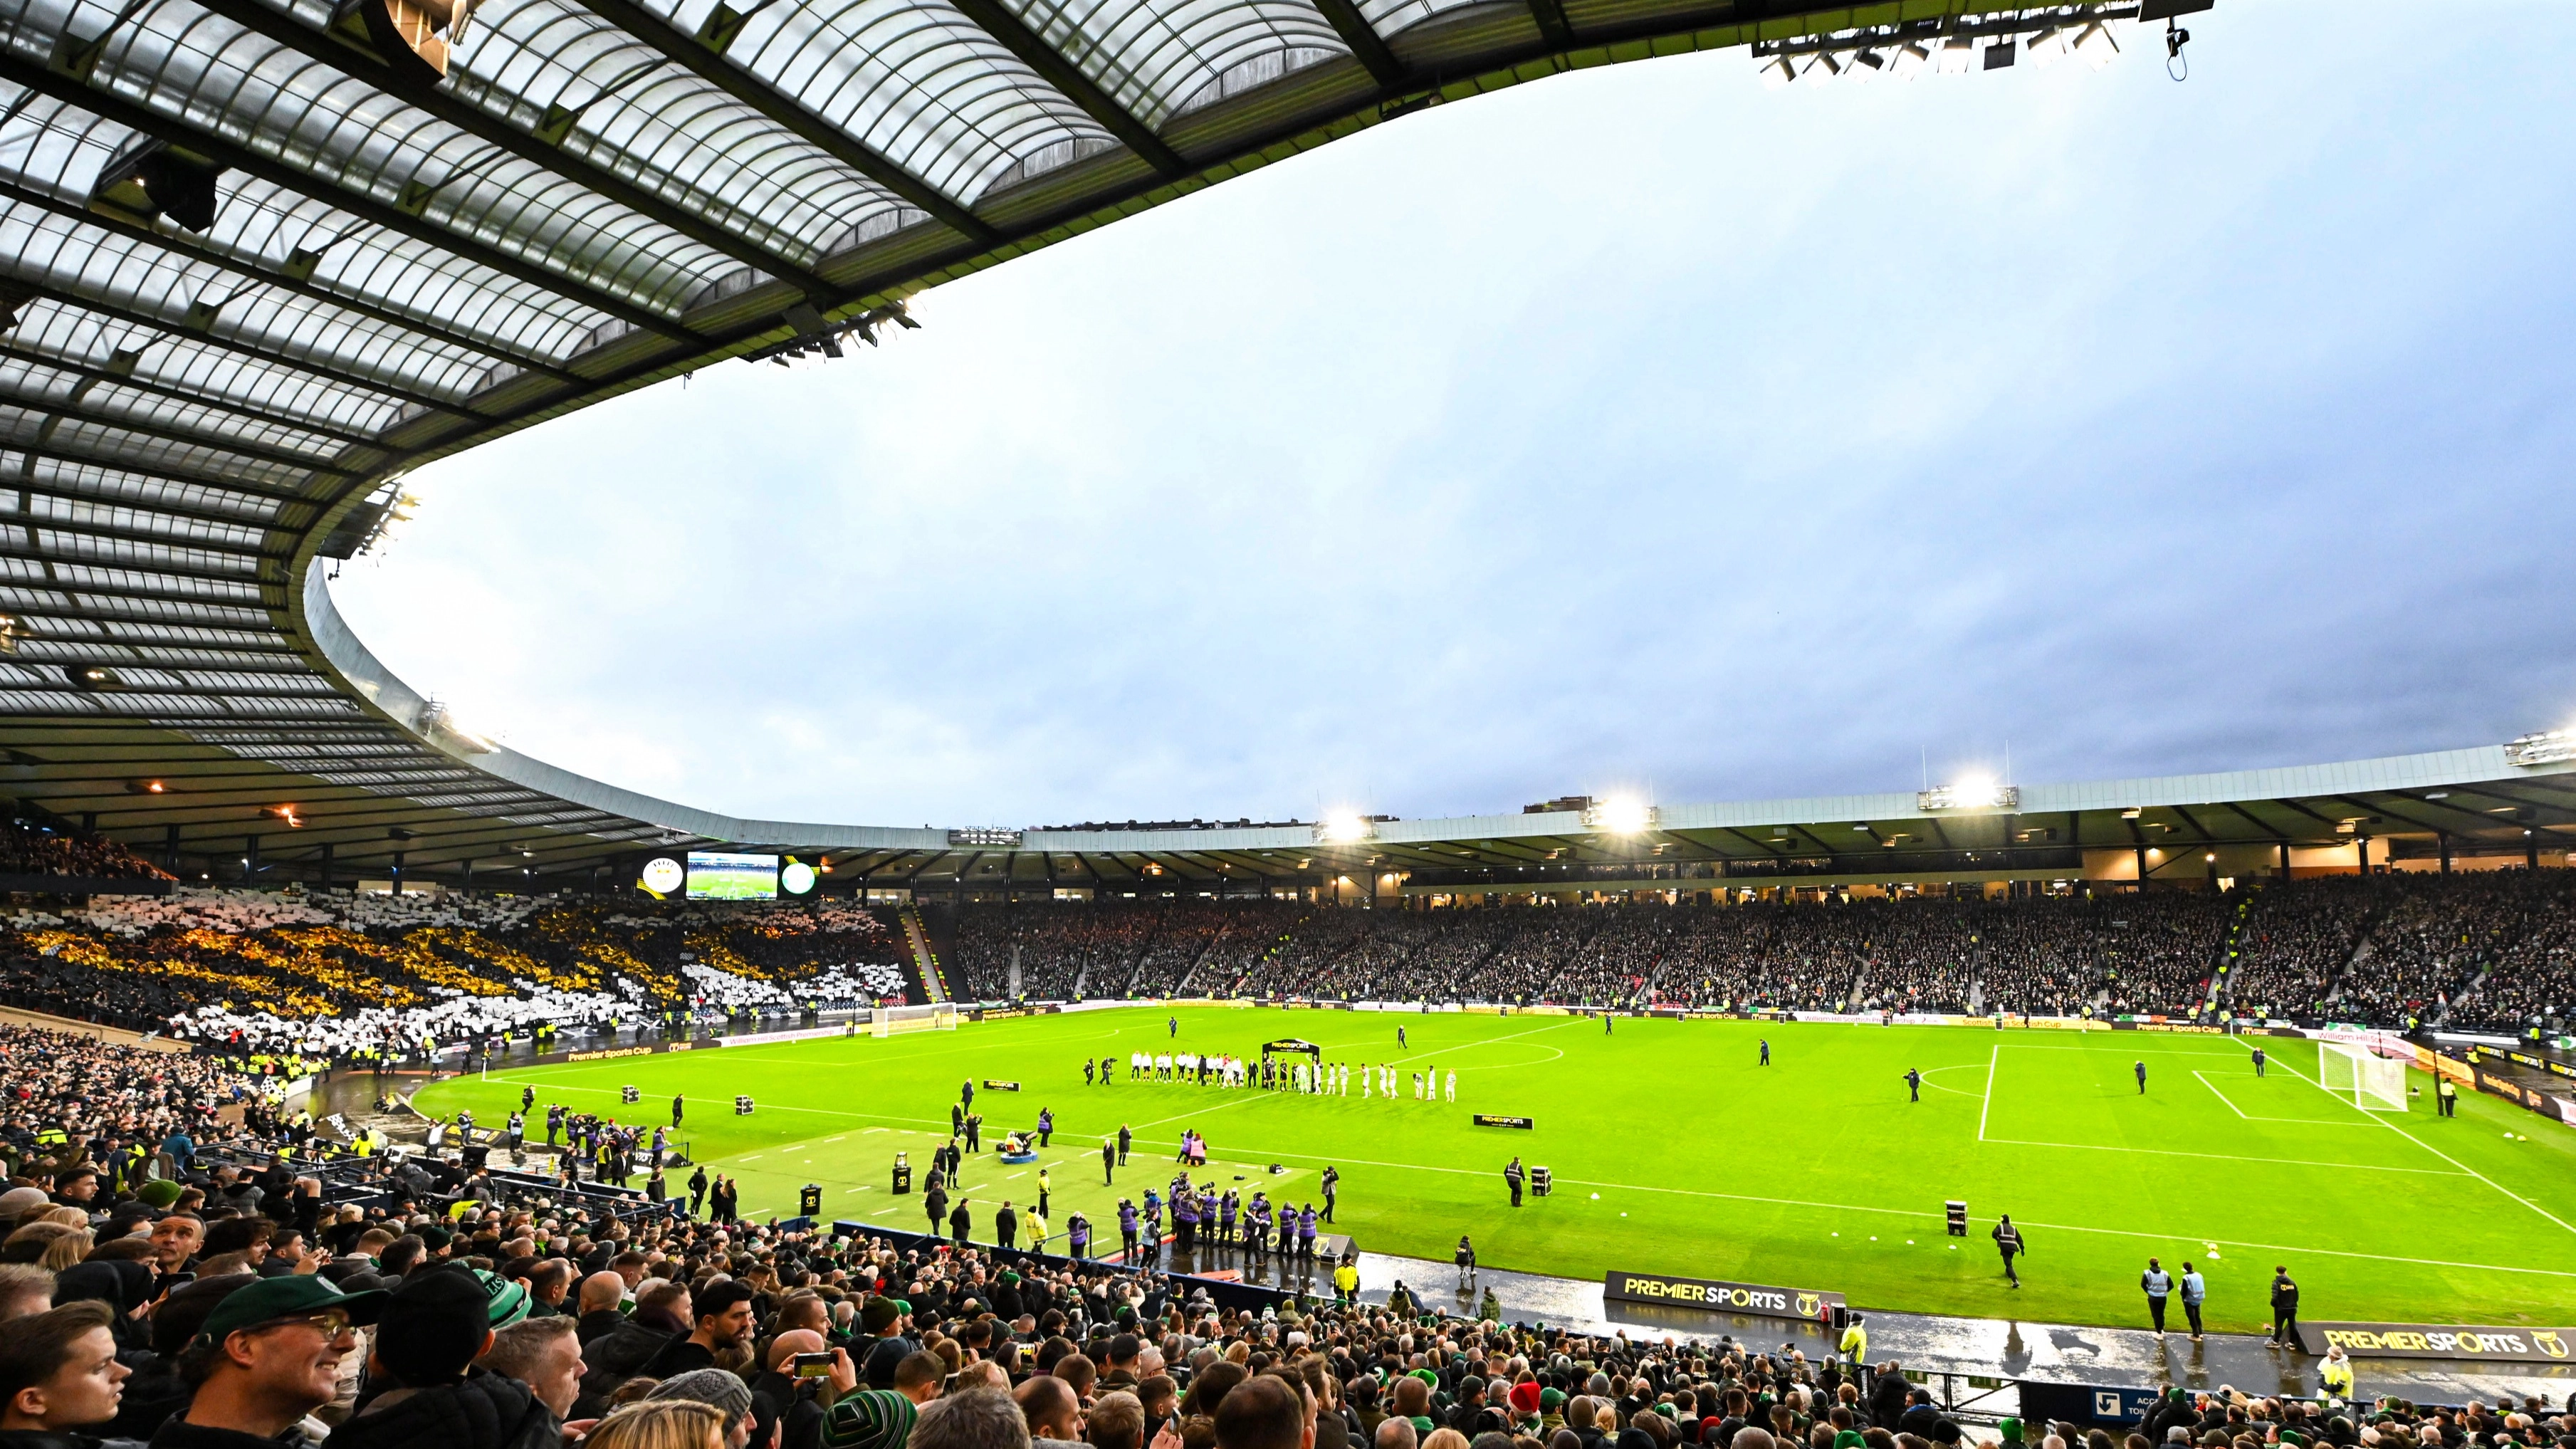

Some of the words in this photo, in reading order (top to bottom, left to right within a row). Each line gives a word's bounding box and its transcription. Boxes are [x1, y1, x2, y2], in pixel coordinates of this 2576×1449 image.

[2137, 1023, 2172, 1032] Premier
[2172, 1025, 2201, 1033] Sports
[730, 1036, 757, 1045] William
[769, 1032, 796, 1042] Scottish
[2318, 1032, 2355, 1041] William
[568, 1050, 604, 1062] Premier
[604, 1047, 633, 1059] Sports
[633, 1047, 652, 1056] Cup
[1625, 1278, 1786, 1310] PREMIERSPORTS
[2324, 1330, 2528, 1354] PREMIERSPORTS
[2127, 1407, 2146, 1416] TOIL
